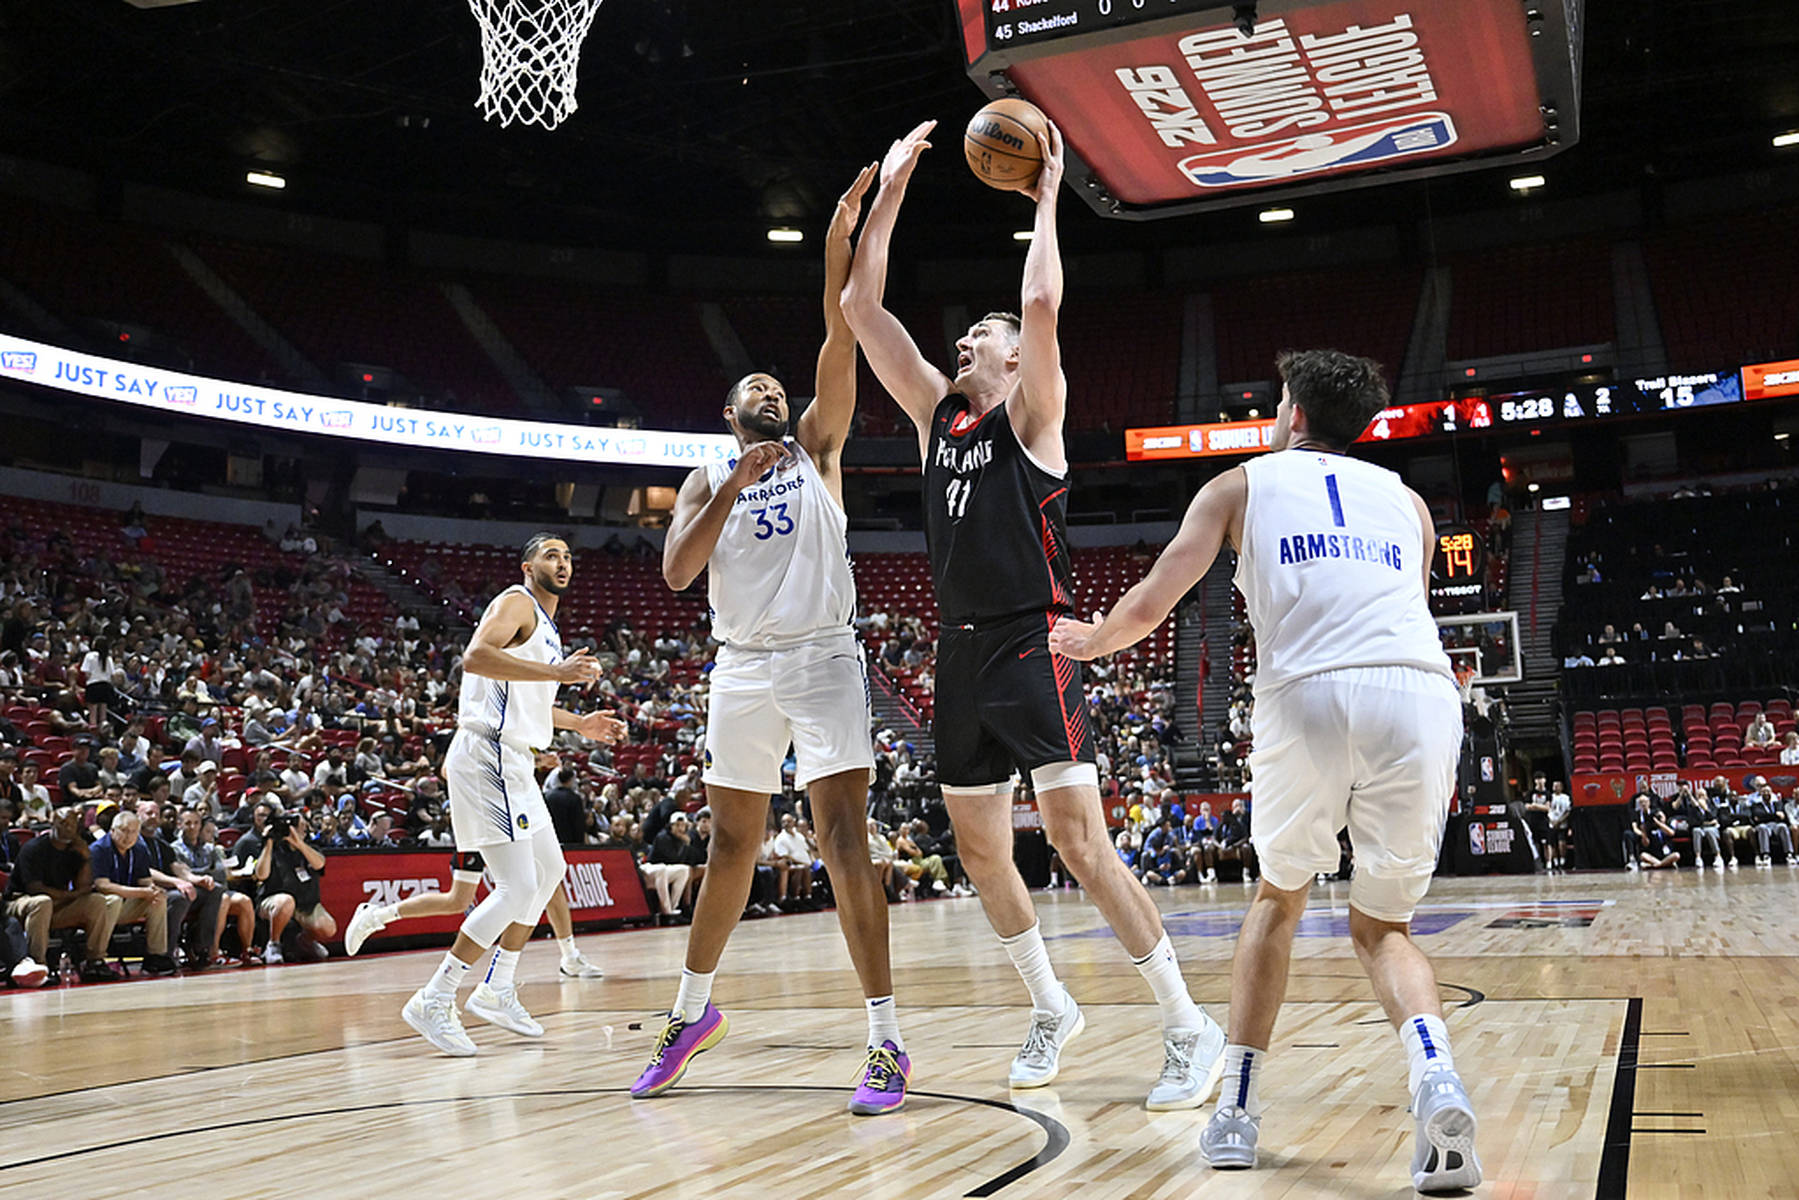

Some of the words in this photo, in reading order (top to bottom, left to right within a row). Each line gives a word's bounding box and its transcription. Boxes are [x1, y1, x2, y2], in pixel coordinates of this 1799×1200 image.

[995, 24, 1013, 40] 45
[1018, 12, 1078, 35] Shackelford
[1178, 18, 1331, 139] SUMMER
[1299, 13, 1439, 121] LEAGUE
[1114, 64, 1218, 148] 2K26
[971, 118, 1025, 151] Wilson
[55, 361, 108, 387] JUST
[115, 374, 158, 397] SAY
[216, 393, 266, 415] JUST
[273, 402, 314, 422] SAY
[1501, 398, 1554, 421] 5:28
[1595, 387, 1611, 404] 2
[1660, 386, 1695, 408] 15
[1444, 404, 1455, 422] 1
[1476, 403, 1487, 417] 1
[371, 415, 420, 434] JUST
[426, 421, 465, 438] SAY
[1372, 418, 1391, 439] 4
[519, 431, 565, 448] JUST
[572, 435, 609, 451] SAY
[663, 443, 709, 458] JUST
[1325, 474, 1346, 527] 1
[750, 502, 795, 540] 33
[1440, 533, 1474, 553] 5:28
[1446, 549, 1474, 579] 14
[563, 863, 615, 909] EAGUE
